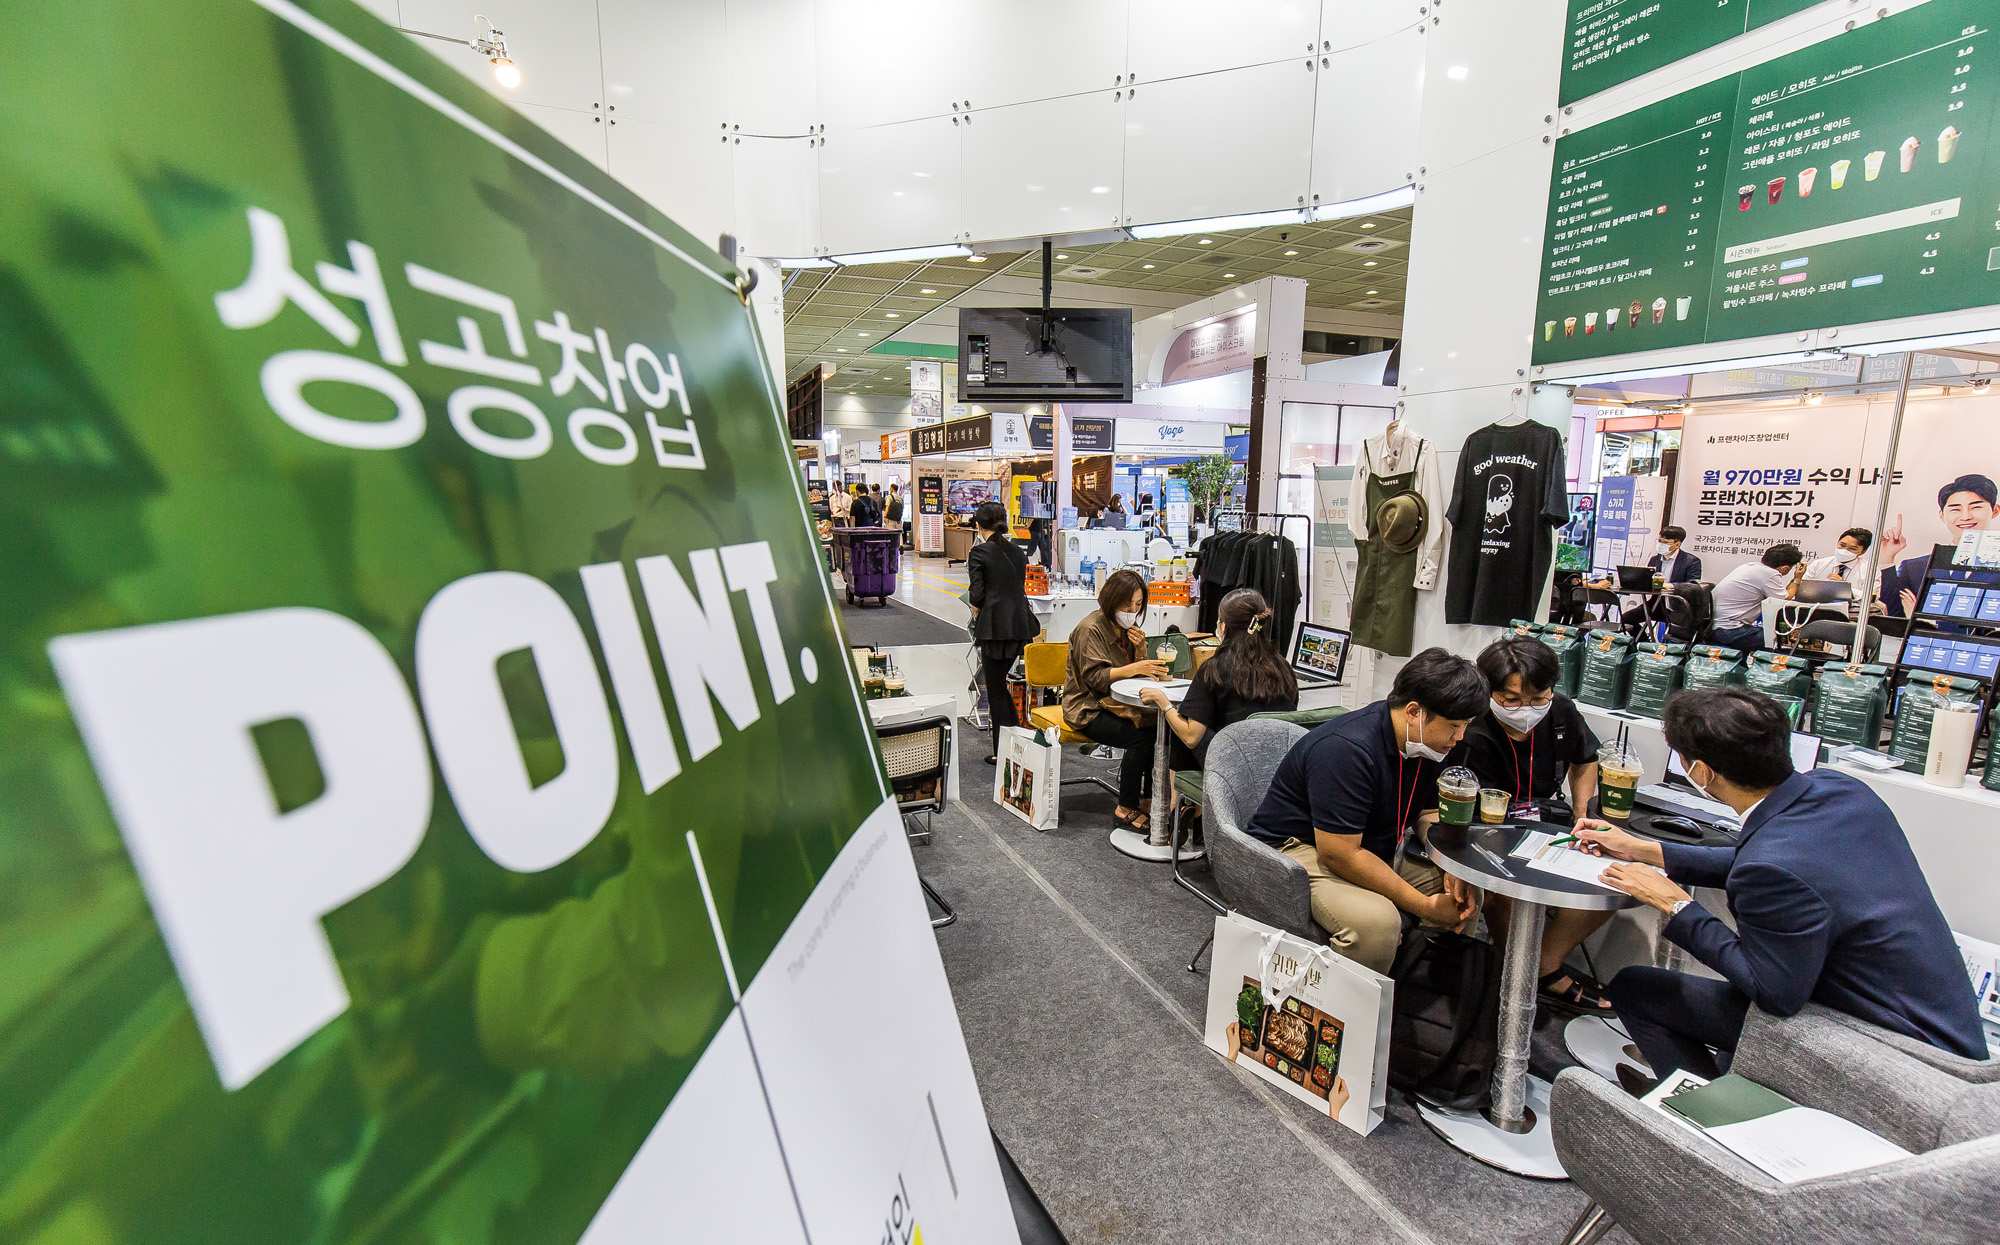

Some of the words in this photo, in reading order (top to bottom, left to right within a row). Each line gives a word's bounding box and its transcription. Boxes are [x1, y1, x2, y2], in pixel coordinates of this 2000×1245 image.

[1961, 25, 1977, 36] ICE
[1751, 90, 1779, 105] 에이드
[1788, 77, 1818, 94] 모히또
[1822, 73, 1836, 82] Ade
[1744, 145, 1761, 155] 레몬
[1768, 136, 1785, 148] 자몽
[1794, 126, 1820, 142] 청포도
[1823, 117, 1851, 132] 에이드
[1746, 123, 1780, 140] 아이스티
[1741, 156, 1775, 171] 그린애플
[1777, 146, 1803, 161] 모히또
[1811, 138, 1831, 151] 라임
[1832, 130, 1861, 145] 모히또
[1930, 207, 1943, 217] ICE
[1925, 232, 1941, 242] 4.5
[1729, 246, 1761, 259] 시즌메뉴
[1766, 242, 1787, 251] Season
[1922, 250, 1938, 258] 4.5
[1726, 266, 1758, 279] 여름시즌
[1760, 263, 1777, 274] 주스
[1724, 280, 1757, 294] 겨울시즌
[1758, 277, 1775, 288] 주스
[214, 205, 705, 470] 성공창업
[1598, 409, 1625, 417] OFFEE
[1158, 424, 1185, 441] Yogo
[1717, 432, 1790, 444] 프랜차이즈창업센터
[1496, 454, 1538, 470] weather
[1702, 469, 1721, 486] 월
[1725, 468, 1803, 486] 970만원
[1807, 467, 1851, 486] 수익
[1607, 498, 1625, 508] 6가지
[1699, 489, 1815, 507] 프랜차이즈가
[1697, 510, 1825, 529] 궁금하신가요?
[1694, 534, 1725, 543] 국가공인
[1727, 536, 1774, 546] 가맹거래사가
[1692, 544, 1739, 555] 프랜차이즈를
[46, 538, 819, 1093] POINT.
[1272, 952, 1322, 990] 귀한발
